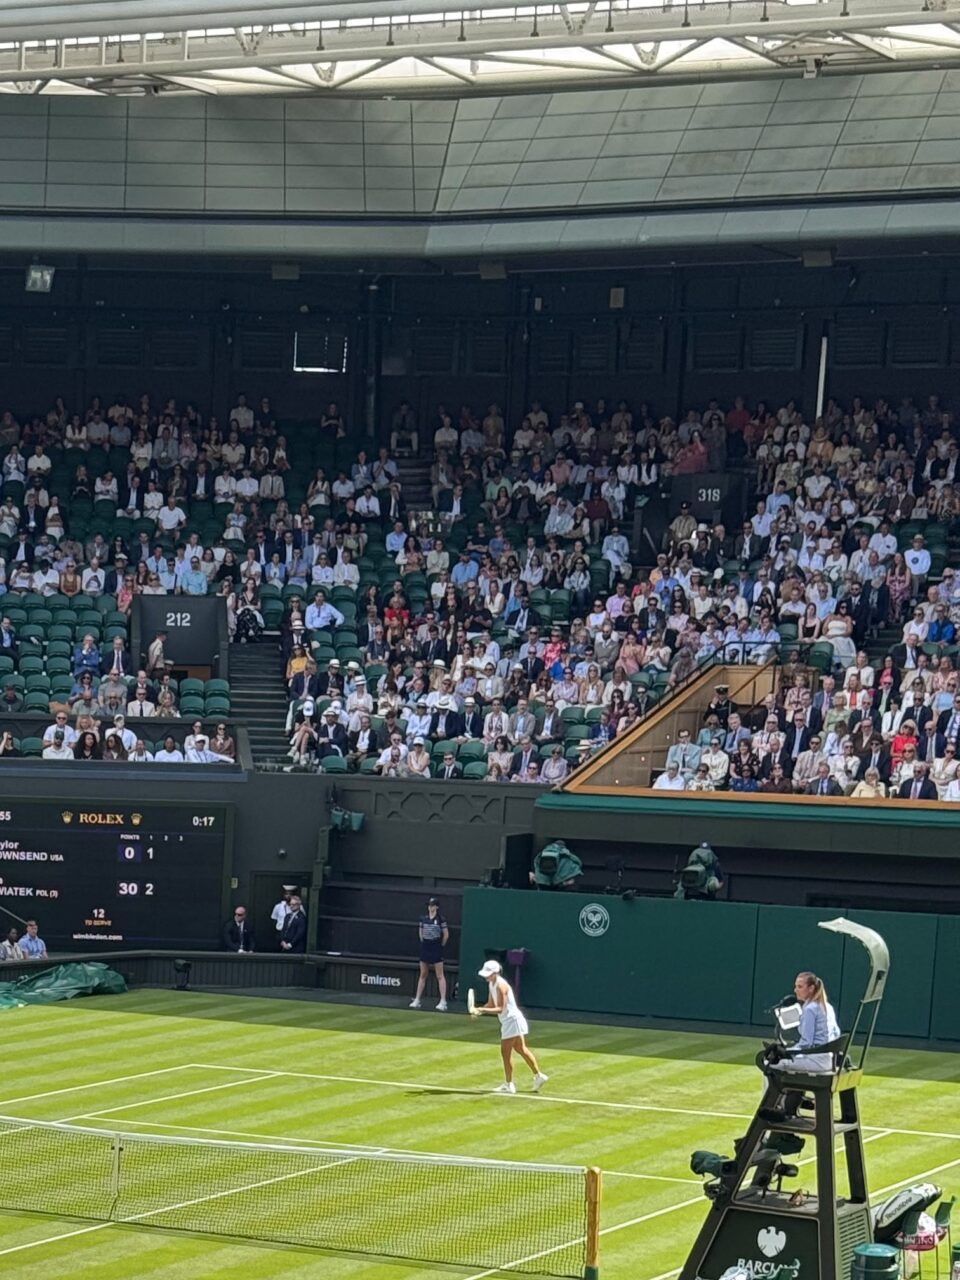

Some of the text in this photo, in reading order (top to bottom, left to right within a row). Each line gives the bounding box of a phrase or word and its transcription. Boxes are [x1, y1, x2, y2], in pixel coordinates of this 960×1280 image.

[698, 488, 720, 502] 318
[166, 612, 191, 627] 212
[79, 813, 124, 825] ROLEX
[192, 816, 215, 827] 0:17
[124, 846, 154, 860] 0 1
[119, 882, 154, 896] 30 2
[92, 908, 105, 919] 12
[360, 973, 401, 987] Emirates
